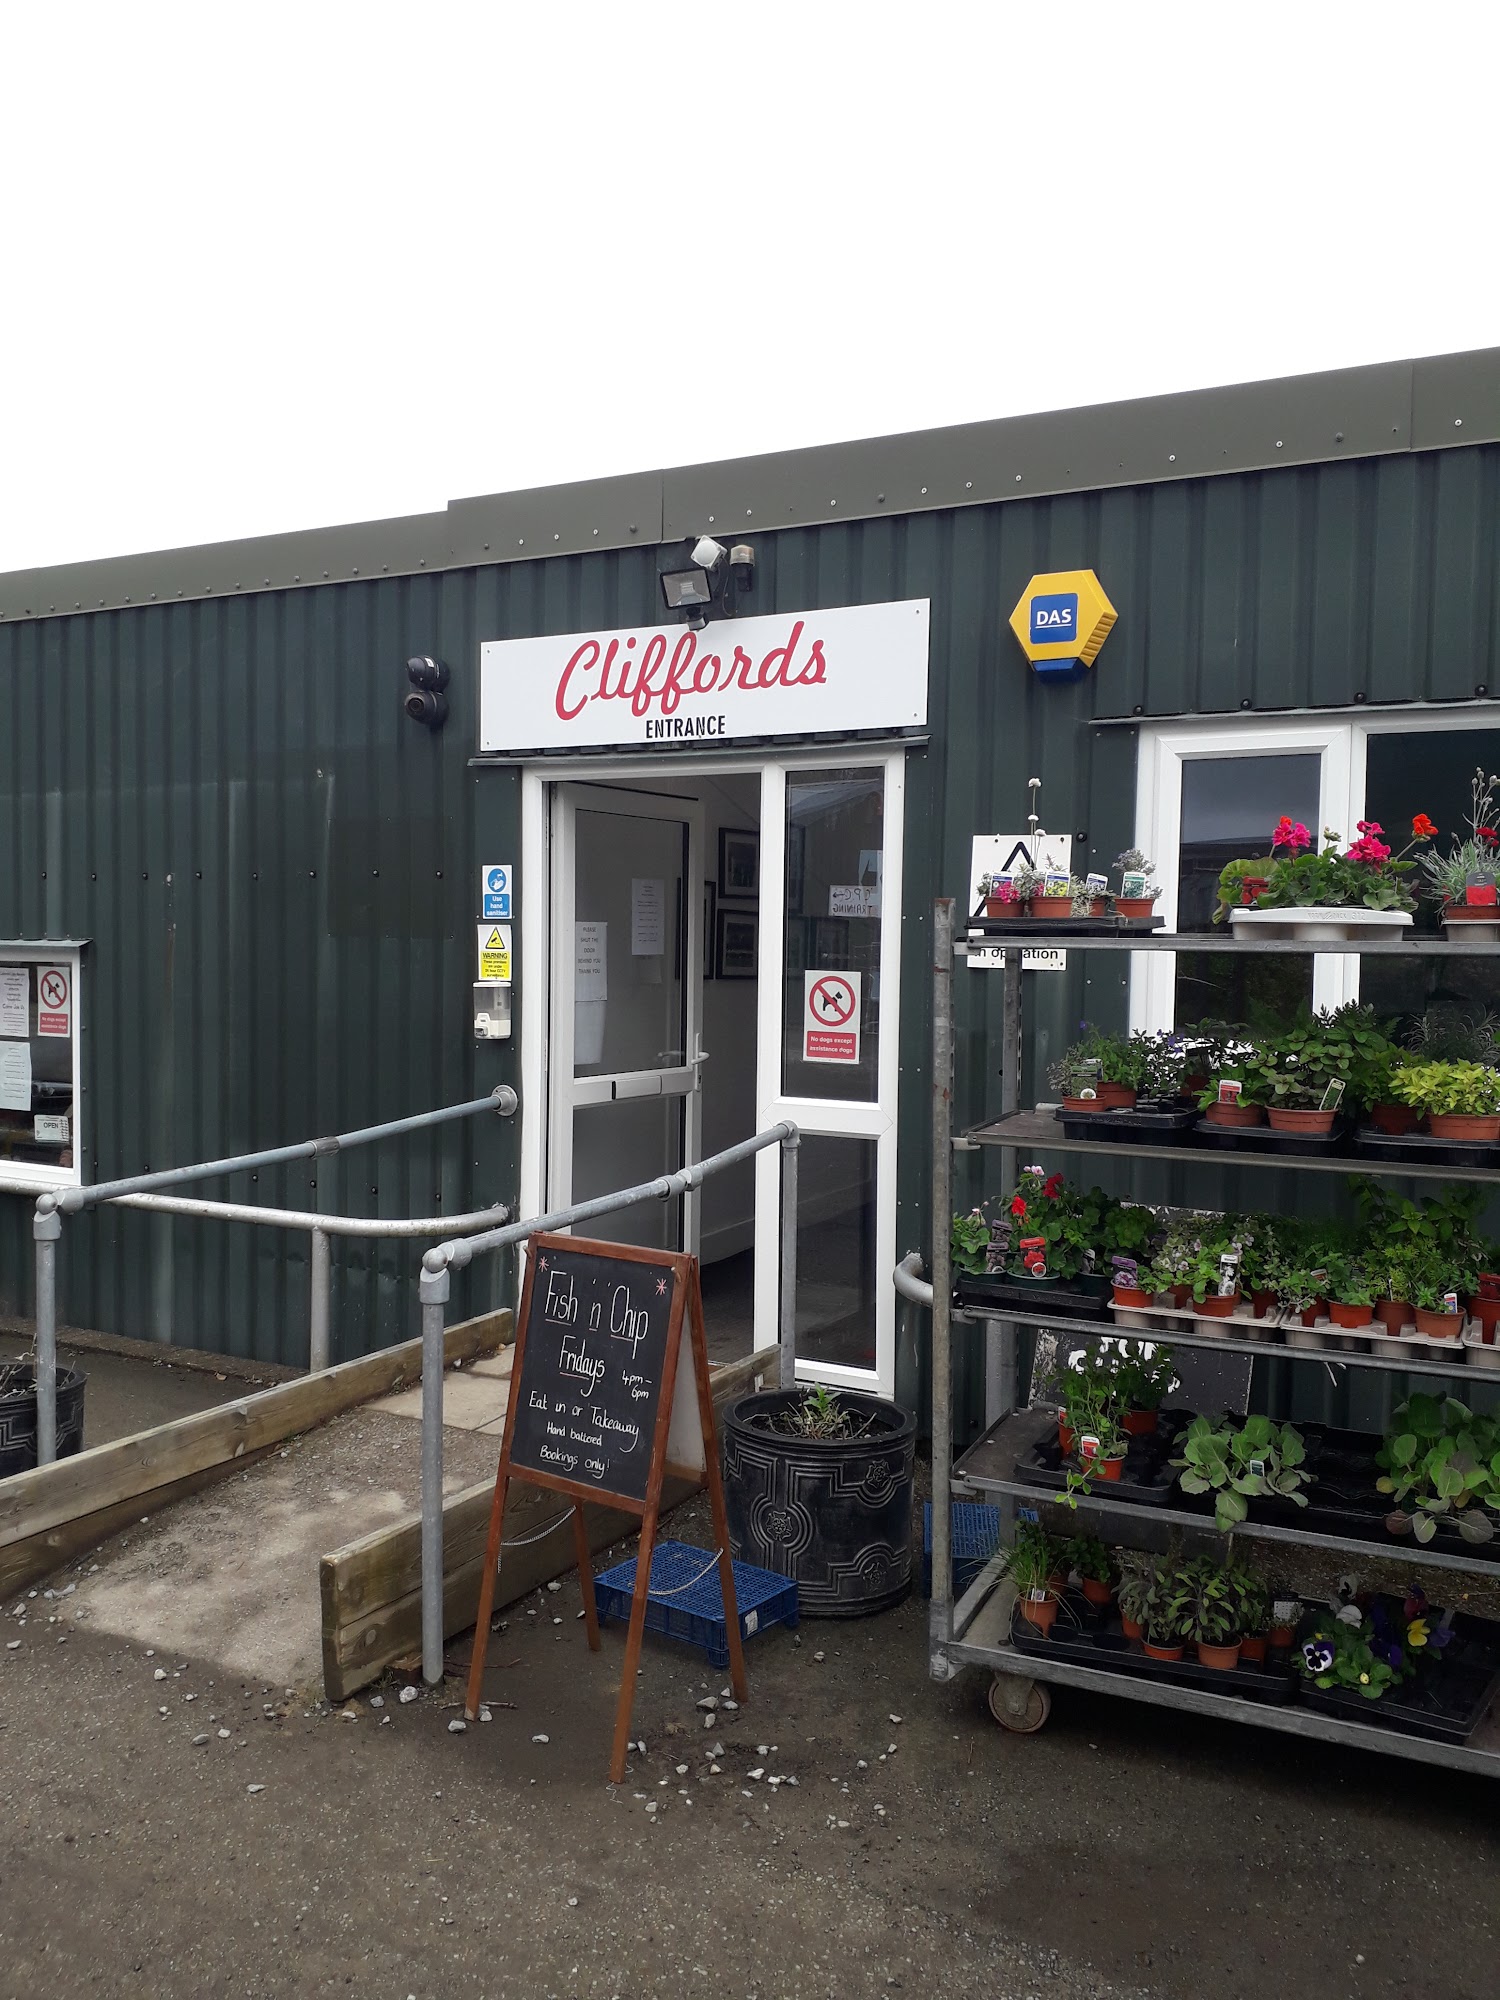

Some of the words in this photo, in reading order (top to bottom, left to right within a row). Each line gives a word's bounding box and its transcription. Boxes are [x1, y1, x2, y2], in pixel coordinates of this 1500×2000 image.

[1036, 608, 1072, 626] DAS
[555, 621, 828, 721] Cliffords
[646, 715, 726, 739] ENTRANCE
[482, 952, 508, 960] WARNING
[991, 949, 1059, 960] opation
[809, 1045, 838, 1053] assistance
[839, 1047, 853, 1055] dogs
[43, 1121, 59, 1129] OPEN
[544, 1270, 578, 1324] Fish
[609, 1285, 649, 1360] Chip
[558, 1334, 606, 1398] Fridays
[631, 1387, 650, 1401] 6pm
[529, 1390, 547, 1411] Eat
[555, 1402, 566, 1413] in
[572, 1406, 584, 1418] or
[590, 1405, 640, 1453] Takeaway
[546, 1421, 566, 1437] Hand
[570, 1429, 603, 1447] battered
[539, 1445, 579, 1472] Bookings
